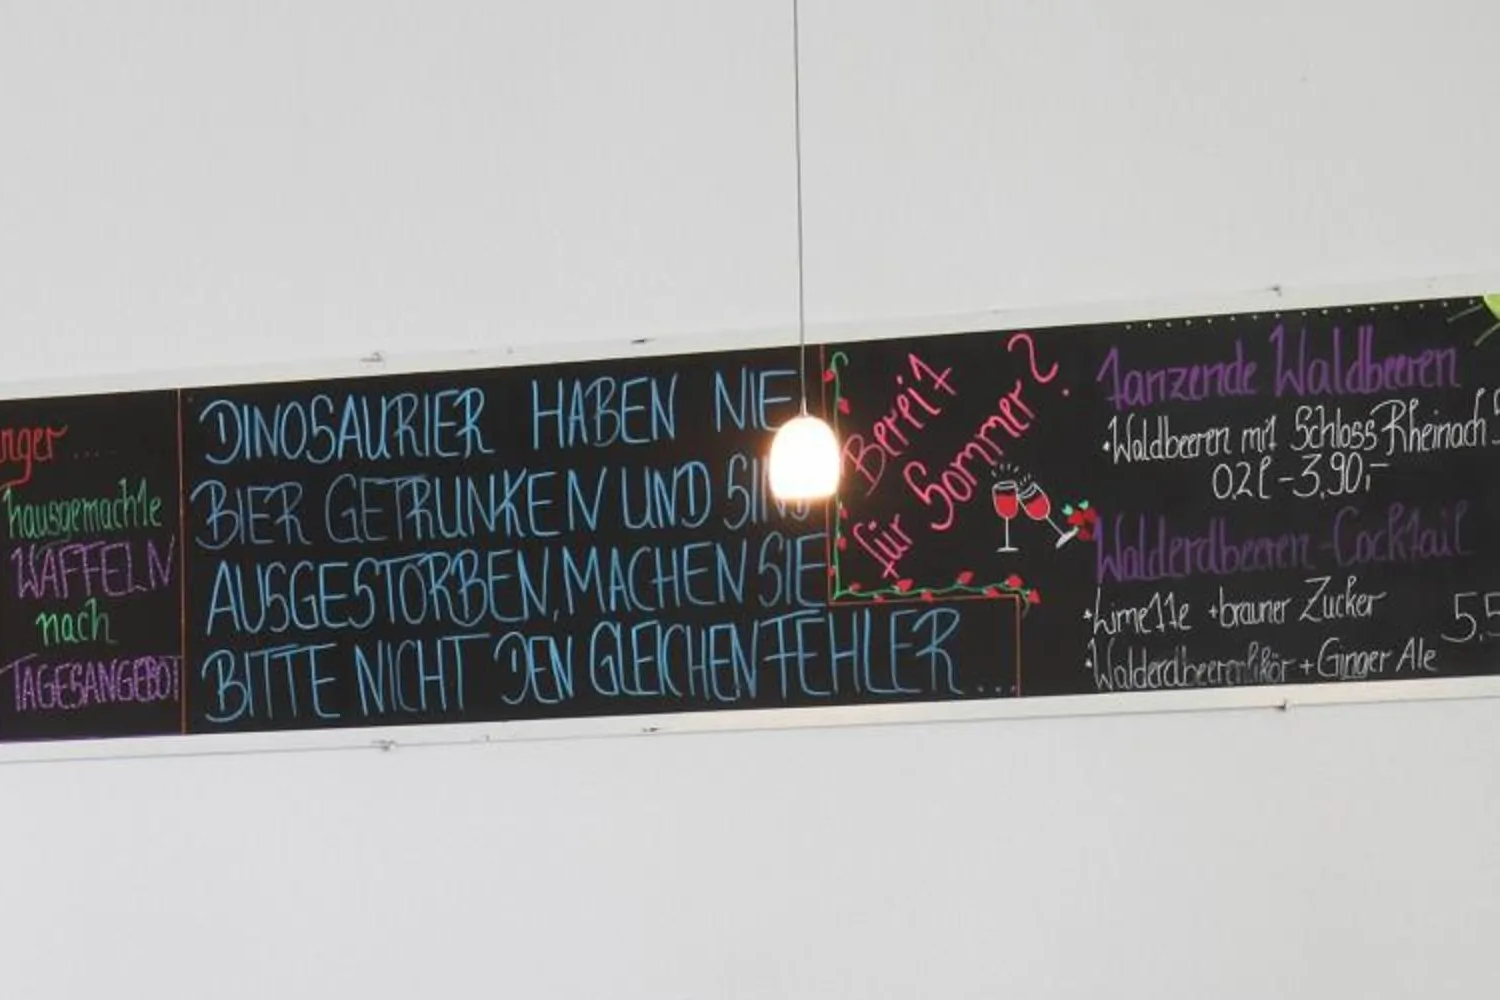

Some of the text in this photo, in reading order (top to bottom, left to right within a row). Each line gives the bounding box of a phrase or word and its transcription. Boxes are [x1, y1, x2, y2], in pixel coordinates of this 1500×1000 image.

[1269, 323, 1461, 397] Waldbeeren
[199, 366, 798, 465] DINOSAURIER HABEN NIE
[839, 352, 957, 497] Bereit
[1107, 412, 1233, 465] Waldbeeren
[1241, 414, 1277, 453] mit
[1290, 404, 1377, 451] Schloss
[2, 477, 163, 541] hausgemachte
[190, 453, 812, 550] BIER GETRUNKEN UND SIN
[10, 534, 176, 600] WAFFELN
[560, 541, 748, 616] MACHEN
[758, 530, 828, 610] SIE
[852, 512, 914, 580] für
[36, 597, 119, 648] nach
[1299, 575, 1388, 622] Zucker
[199, 642, 342, 724] BITTE
[355, 632, 491, 717] NICHT
[493, 631, 576, 704] DEN
[588, 617, 759, 702] GLEICHEN
[1316, 636, 1393, 681] Ginger
[1395, 638, 1440, 674] Ale
